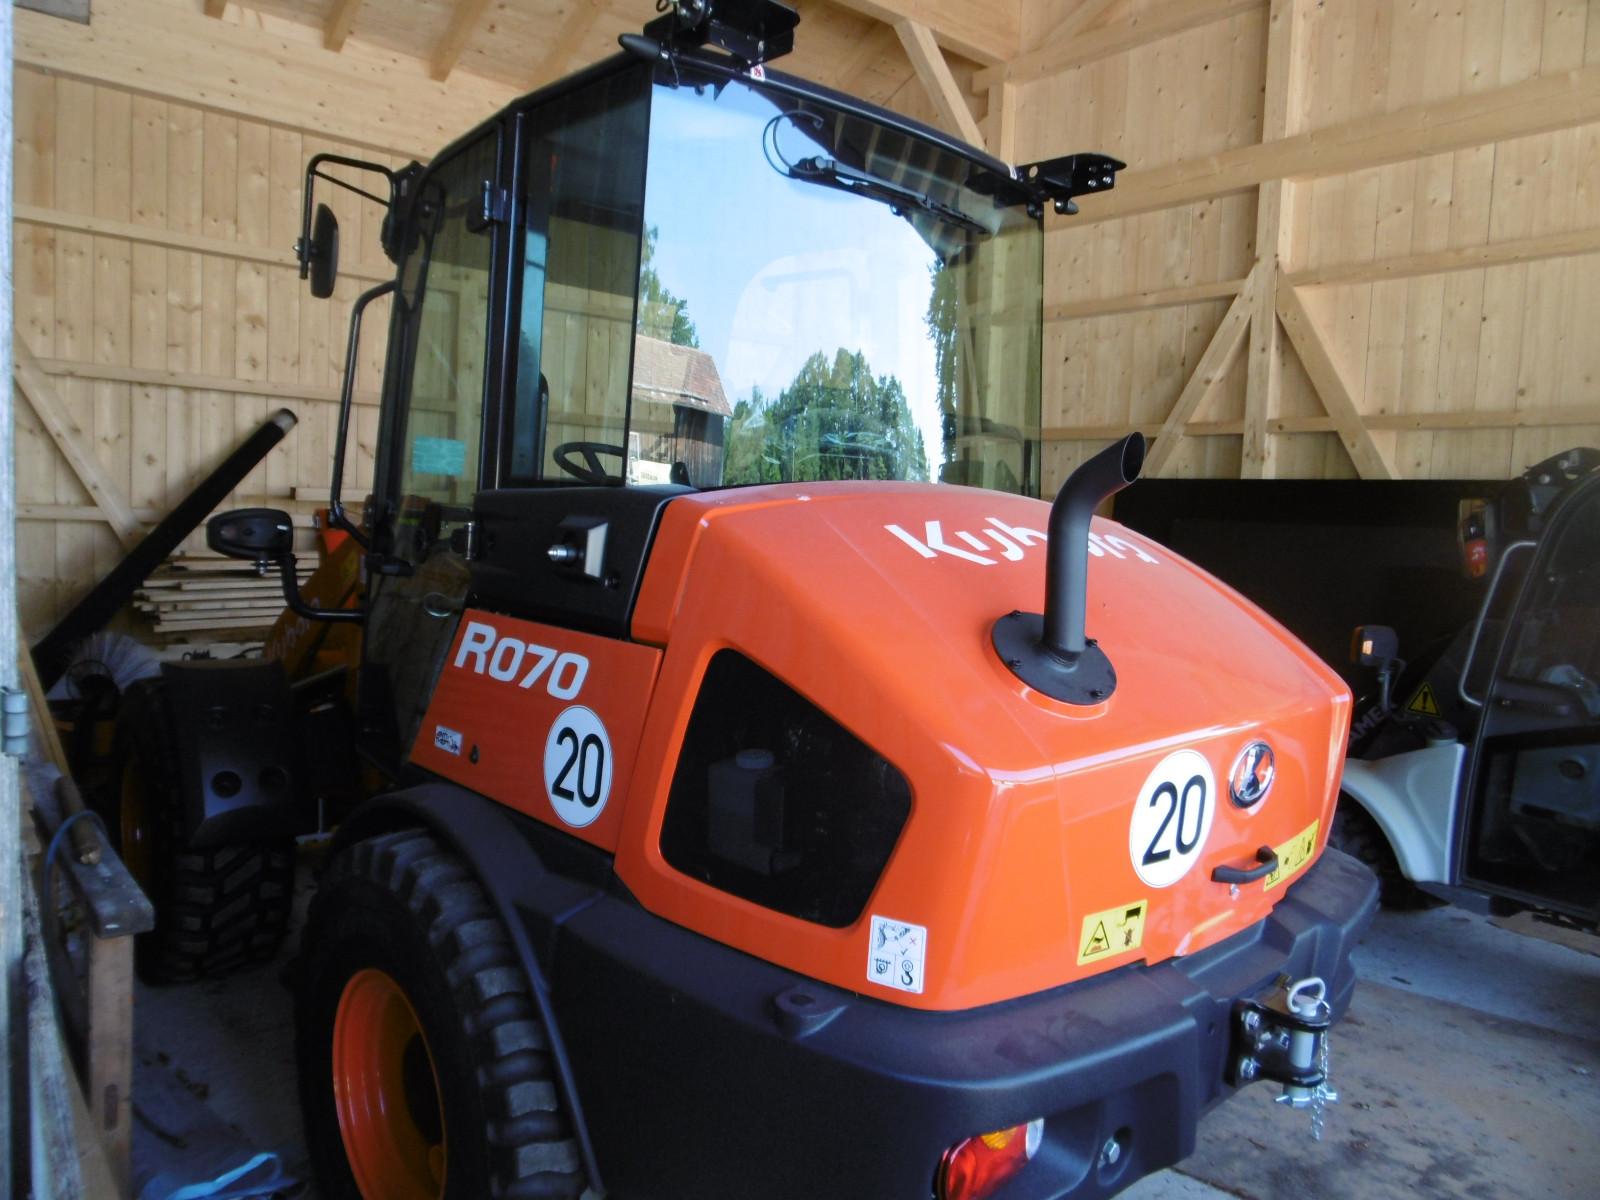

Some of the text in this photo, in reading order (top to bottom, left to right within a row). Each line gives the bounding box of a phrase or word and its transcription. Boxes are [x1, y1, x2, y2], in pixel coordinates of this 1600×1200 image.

[884, 517, 1159, 565] Kubta
[454, 622, 589, 701] R070
[552, 727, 604, 808] 20
[1142, 775, 1206, 866] 20
